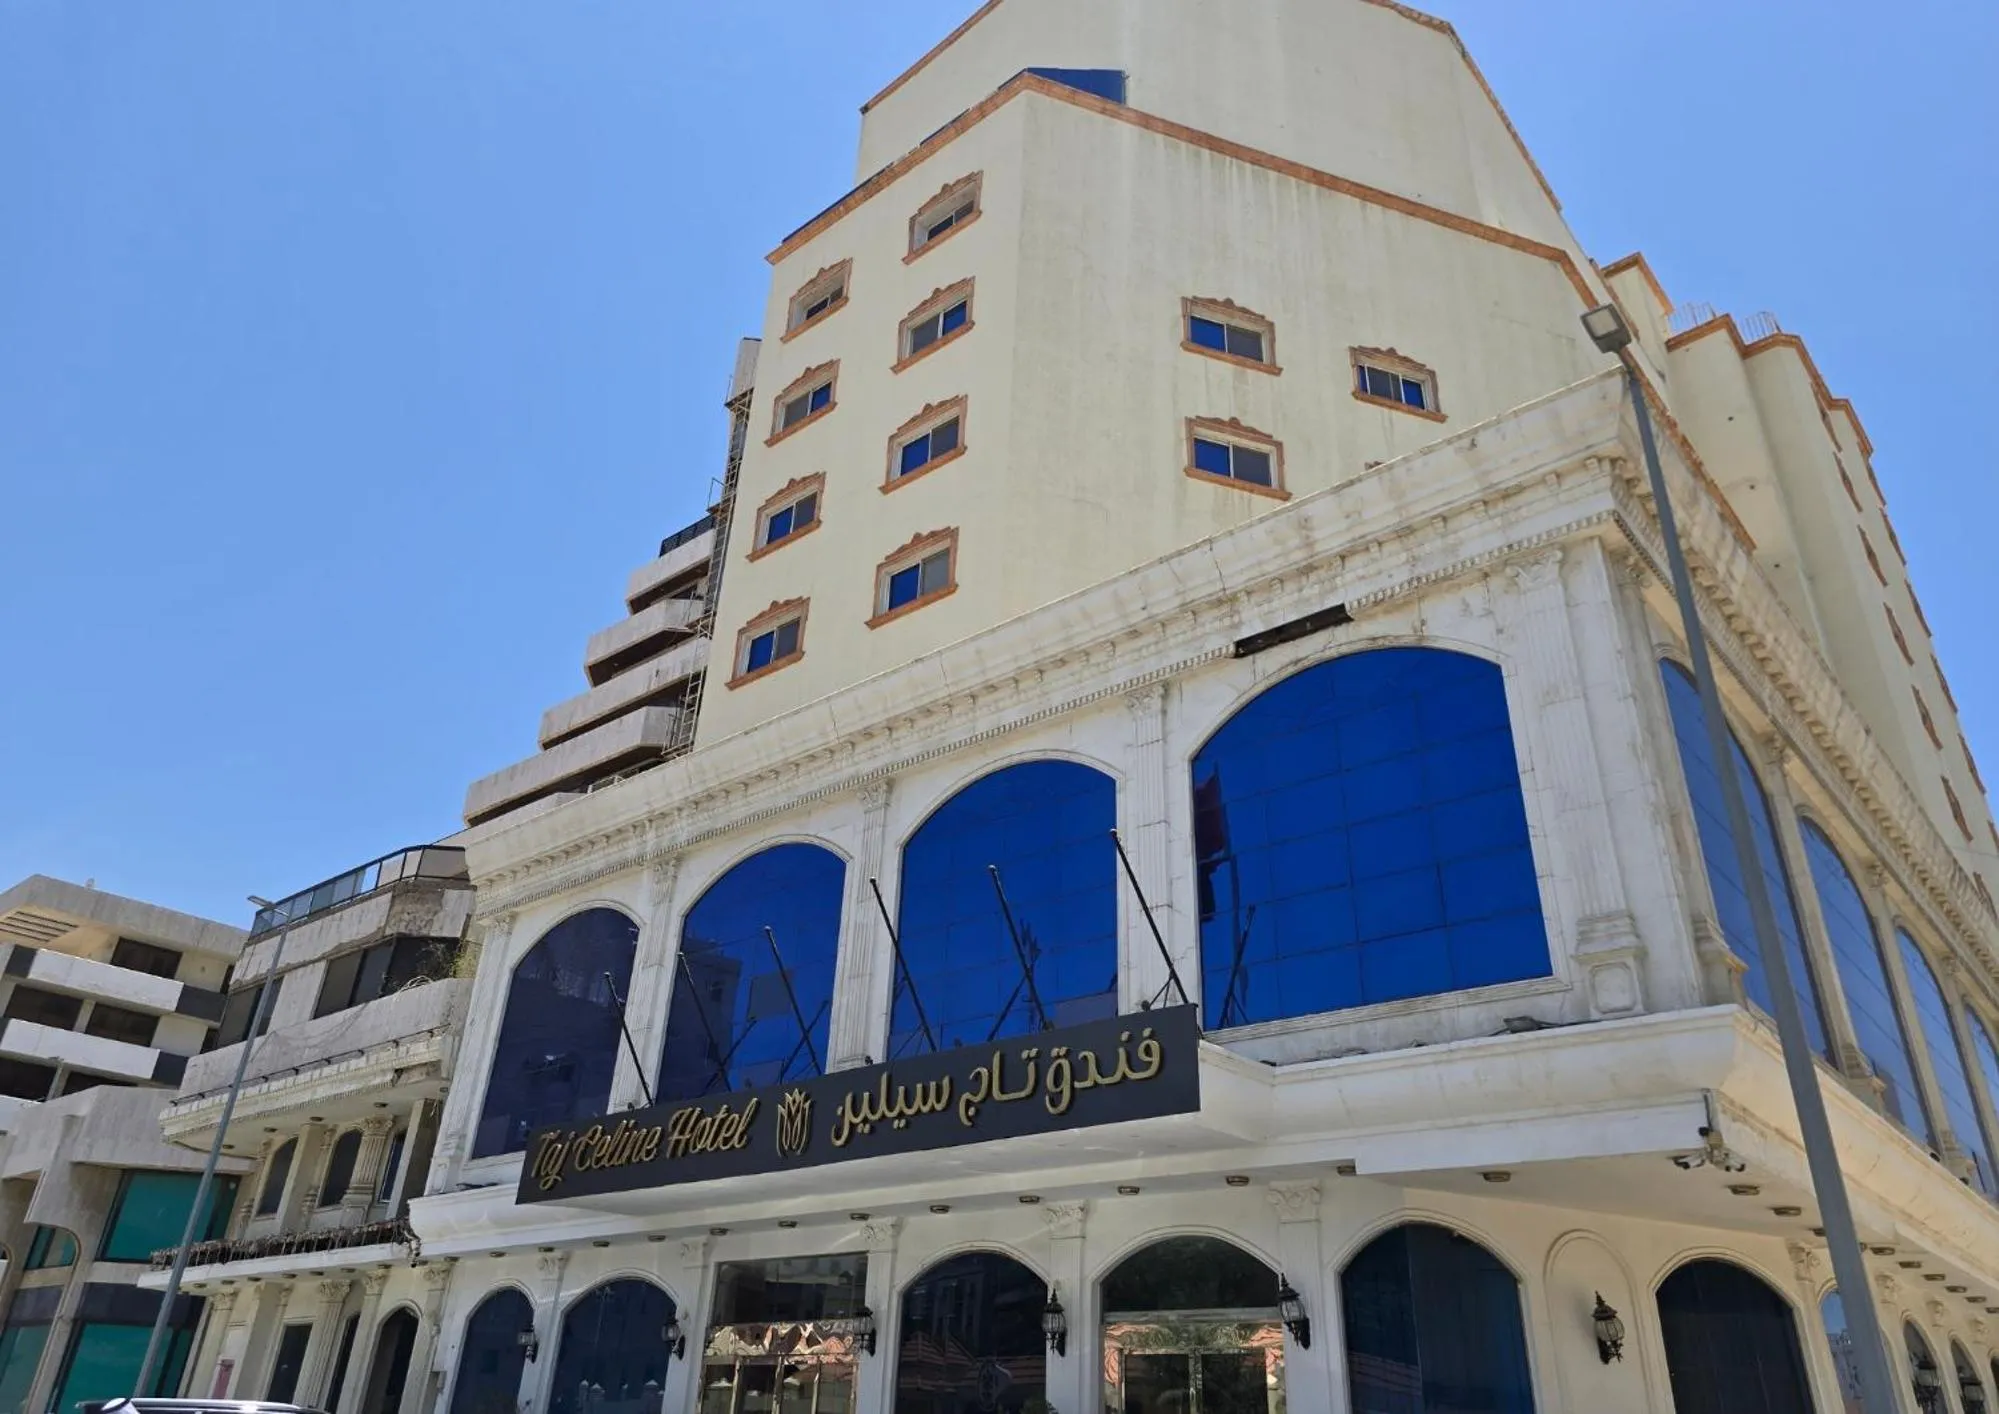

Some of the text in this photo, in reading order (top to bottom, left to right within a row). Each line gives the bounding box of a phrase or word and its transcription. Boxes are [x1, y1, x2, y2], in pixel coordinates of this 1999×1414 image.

[831, 1028, 1162, 1147] فندق تاج سيلين
[531, 1097, 760, 1191] Taj Celine Hotel
